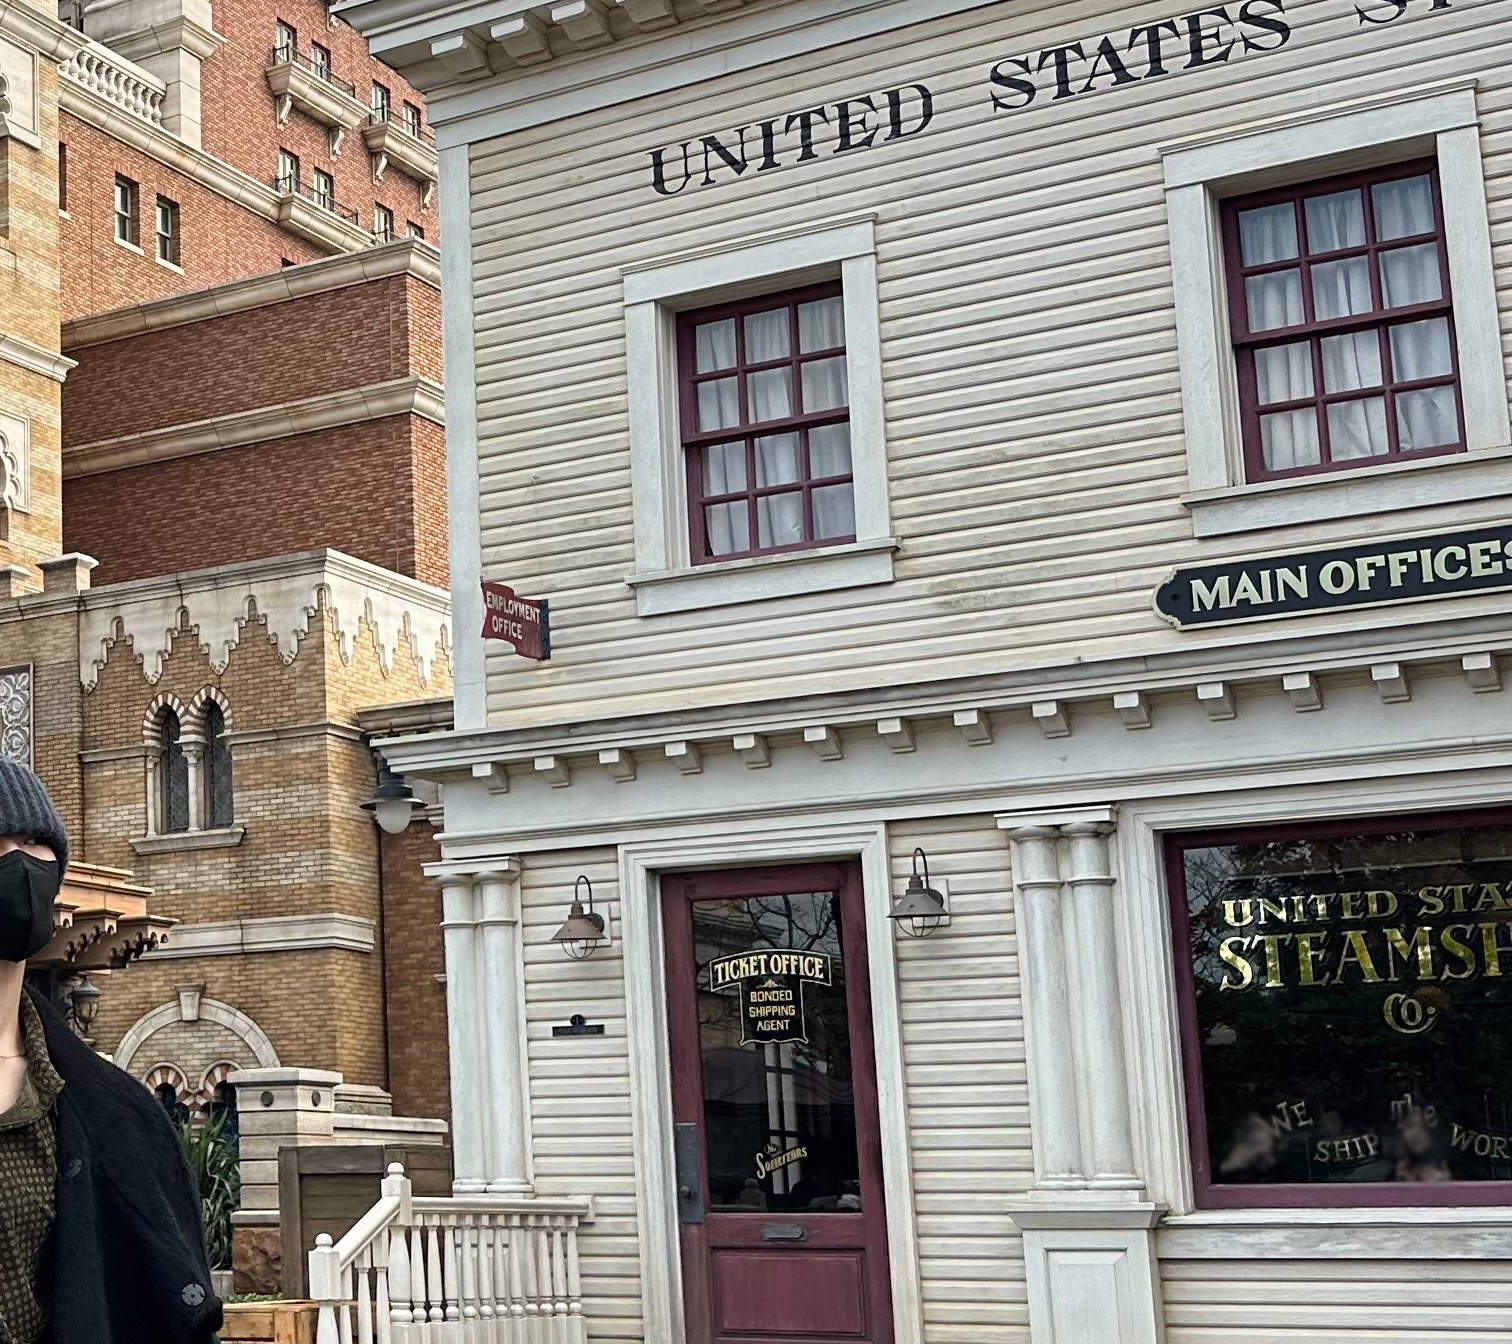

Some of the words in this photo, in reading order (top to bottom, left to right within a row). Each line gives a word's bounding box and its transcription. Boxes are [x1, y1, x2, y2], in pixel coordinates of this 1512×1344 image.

[646, 83, 934, 197] UNITED
[1189, 564, 1310, 613] MAIN
[1318, 539, 1512, 595] OFFICE
[486, 590, 541, 624] EMPLOYMENT
[491, 615, 523, 640] OFFICE
[1221, 889, 1399, 927] UNITED
[1417, 882, 1512, 917] STA
[713, 954, 768, 984] TICKET
[769, 954, 825, 979] OFFICE
[749, 1004, 796, 1018] SHIPPING
[750, 990, 793, 1003] BONDED
[756, 1019, 790, 1032] AGENT
[1250, 1099, 1314, 1138] WE
[1313, 1133, 1379, 1162] SHIP
[1449, 1121, 1512, 1159] WOR
